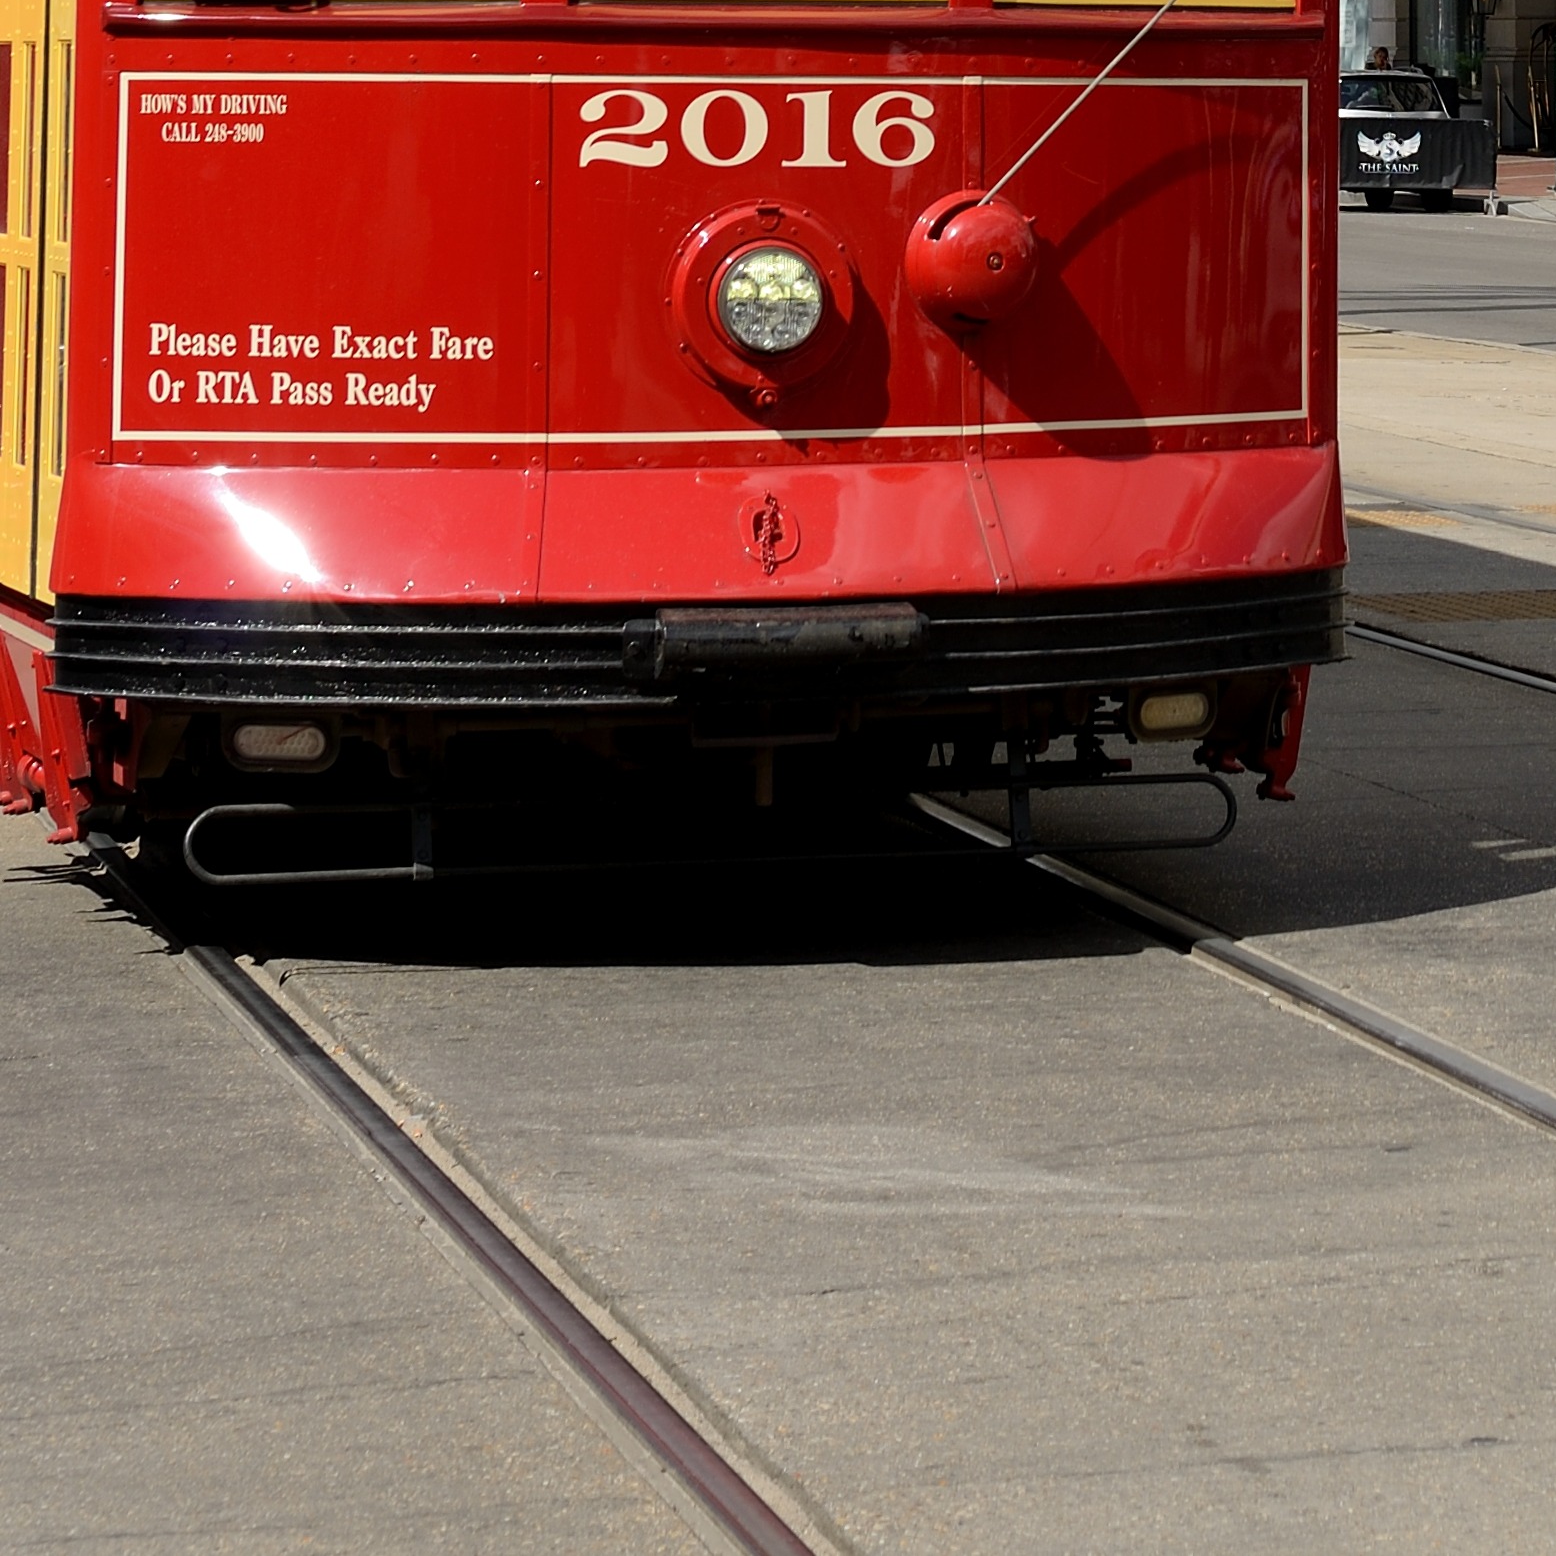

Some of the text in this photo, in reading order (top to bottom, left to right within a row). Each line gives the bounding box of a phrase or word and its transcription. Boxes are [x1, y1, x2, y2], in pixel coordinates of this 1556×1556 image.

[140, 93, 288, 115] HOW'S MY DRIVING
[161, 122, 264, 143] CALL 248-3900
[579, 89, 936, 168] 2016
[1360, 162, 1417, 173] THE SAINT
[149, 322, 494, 360] Please Have Exact Fare
[148, 369, 436, 413] Or RTA Pass Ready
